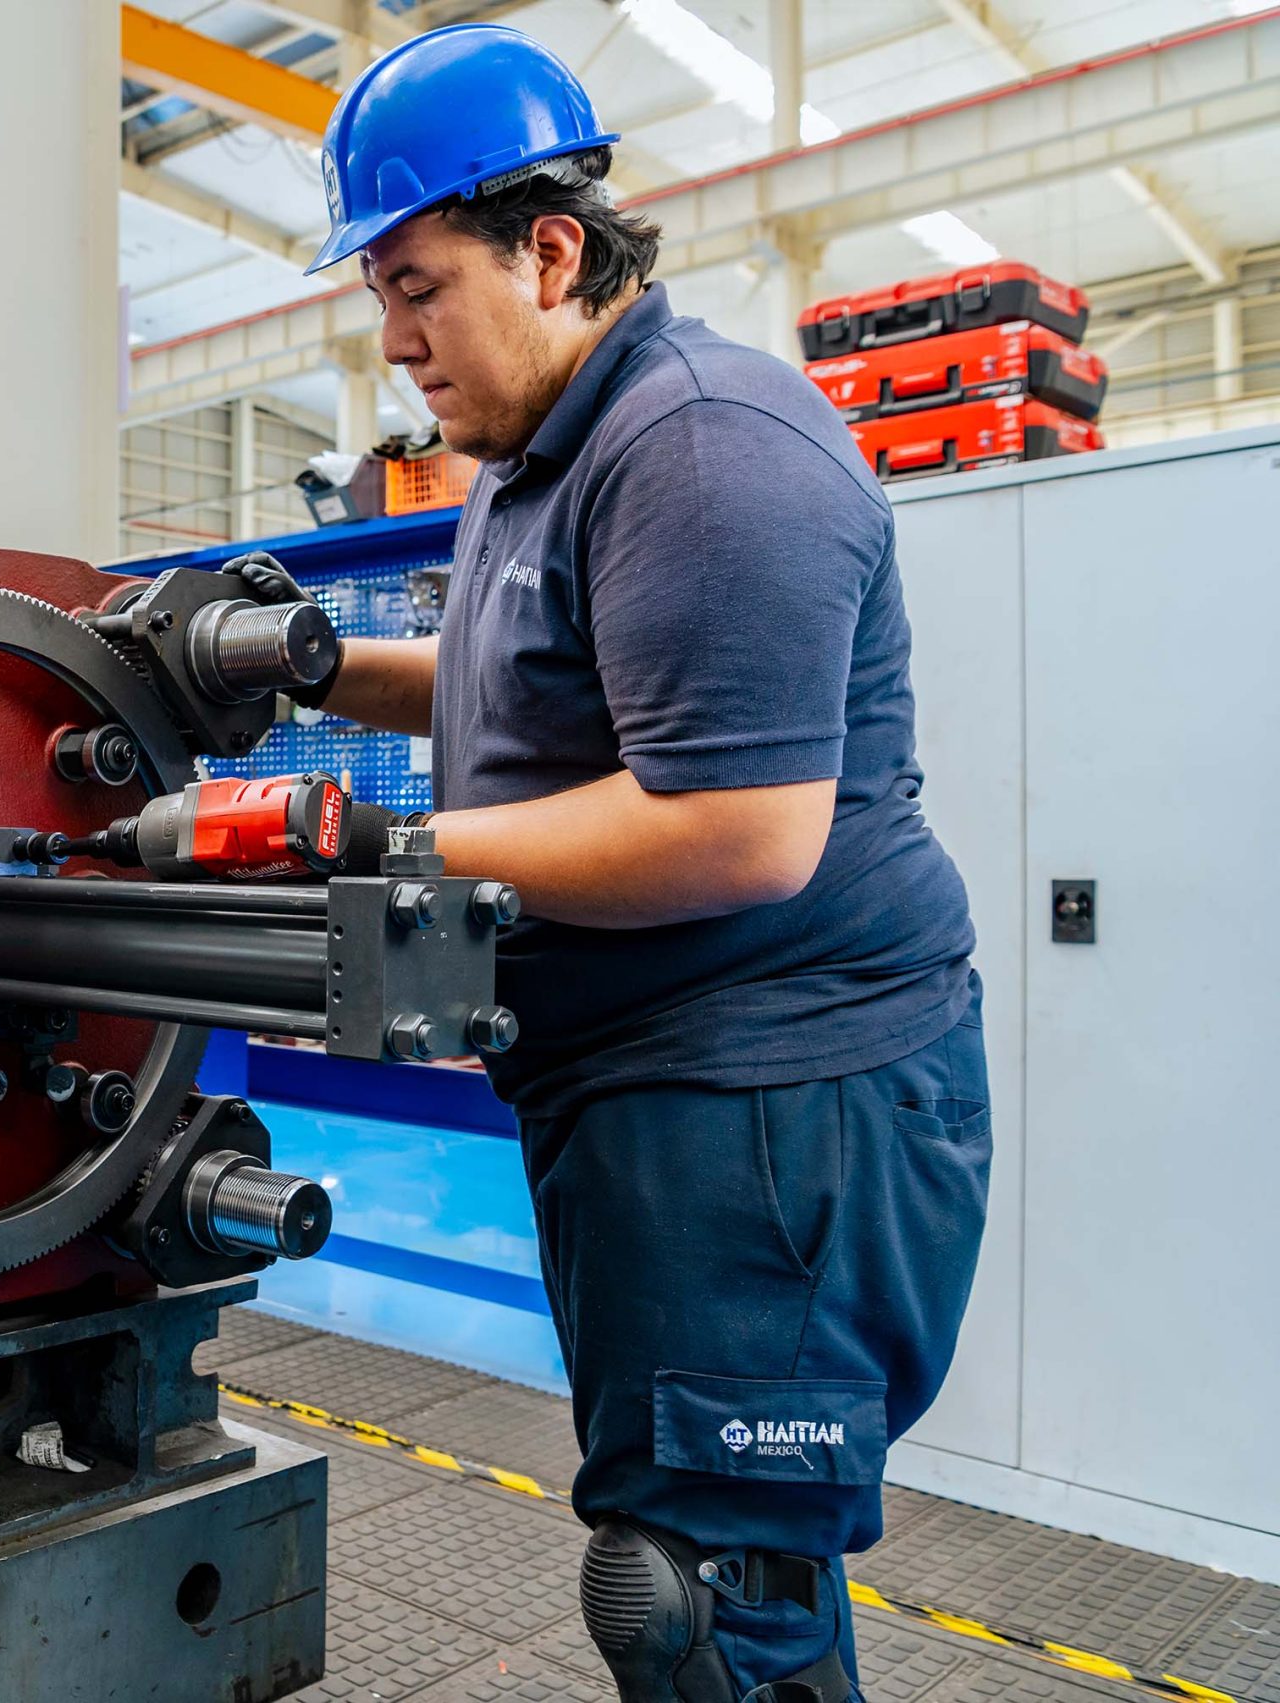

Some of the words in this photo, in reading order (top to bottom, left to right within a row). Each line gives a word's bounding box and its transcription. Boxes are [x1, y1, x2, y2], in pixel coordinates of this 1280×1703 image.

[325, 166, 337, 196] HT
[322, 791, 336, 850] FUEL
[330, 793, 341, 853] BRUSHLESS
[227, 860, 294, 879] Milwaukee
[726, 1427, 748, 1441] HT
[757, 1421, 845, 1445] HAITIAN
[757, 1445, 803, 1456] MEXICO
